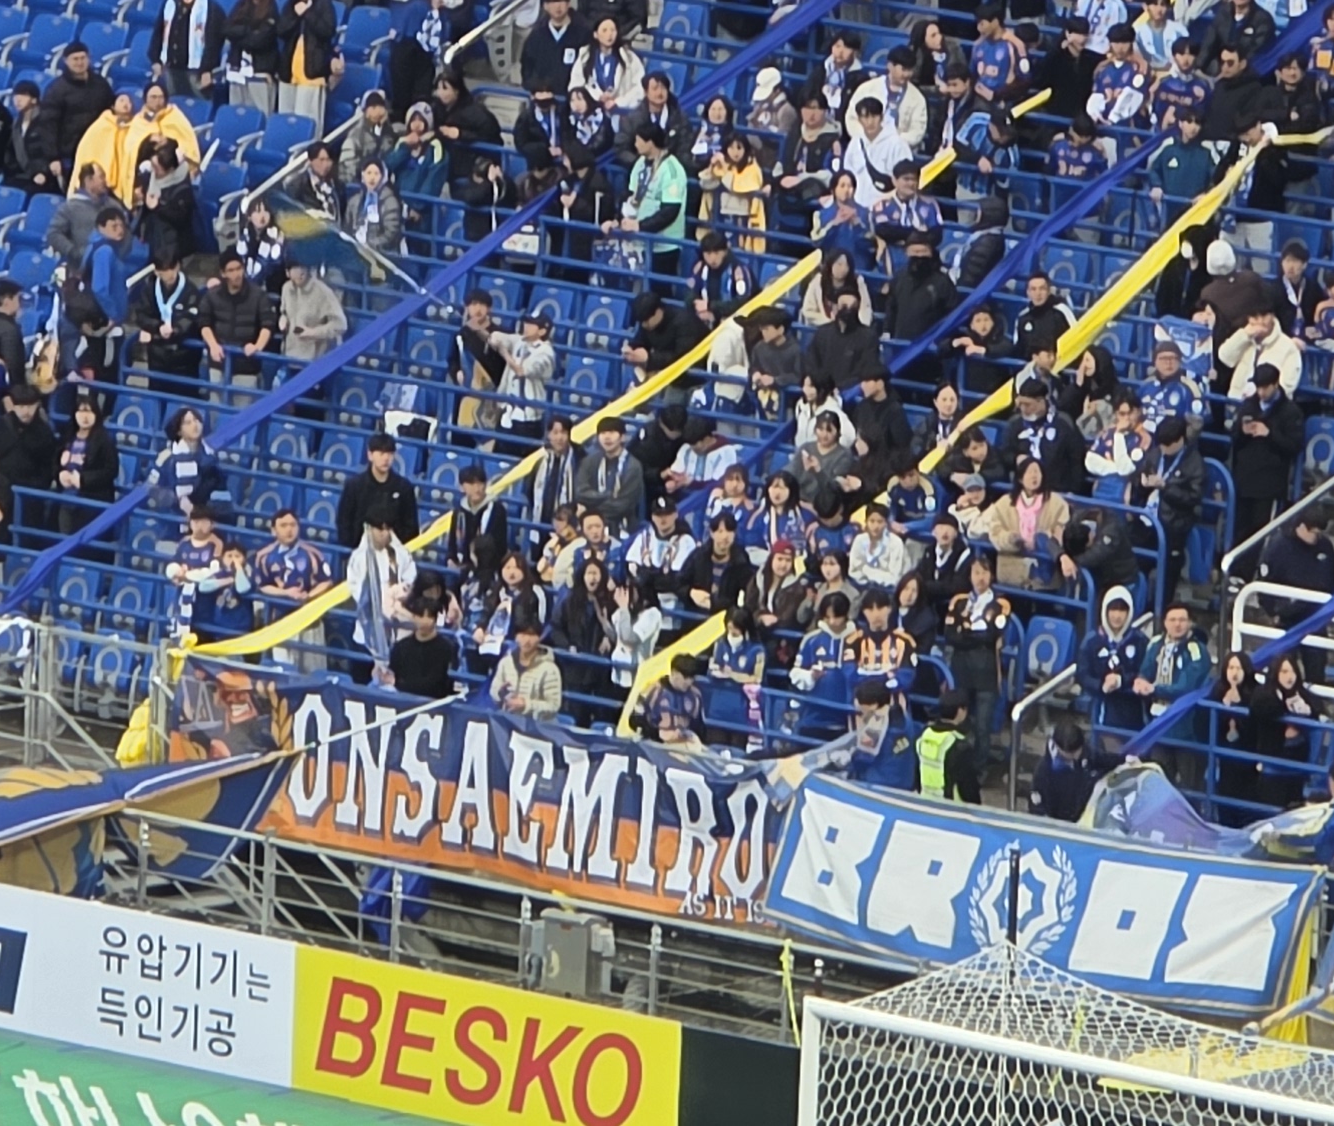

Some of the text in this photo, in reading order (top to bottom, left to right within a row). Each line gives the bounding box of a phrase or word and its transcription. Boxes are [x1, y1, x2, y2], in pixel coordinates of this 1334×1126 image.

[288, 693, 767, 900] ONSAEMIRO
[98, 925, 271, 1003] 유압기기는
[97, 986, 236, 1058] 득인기공
[314, 975, 644, 1126] BESKO
